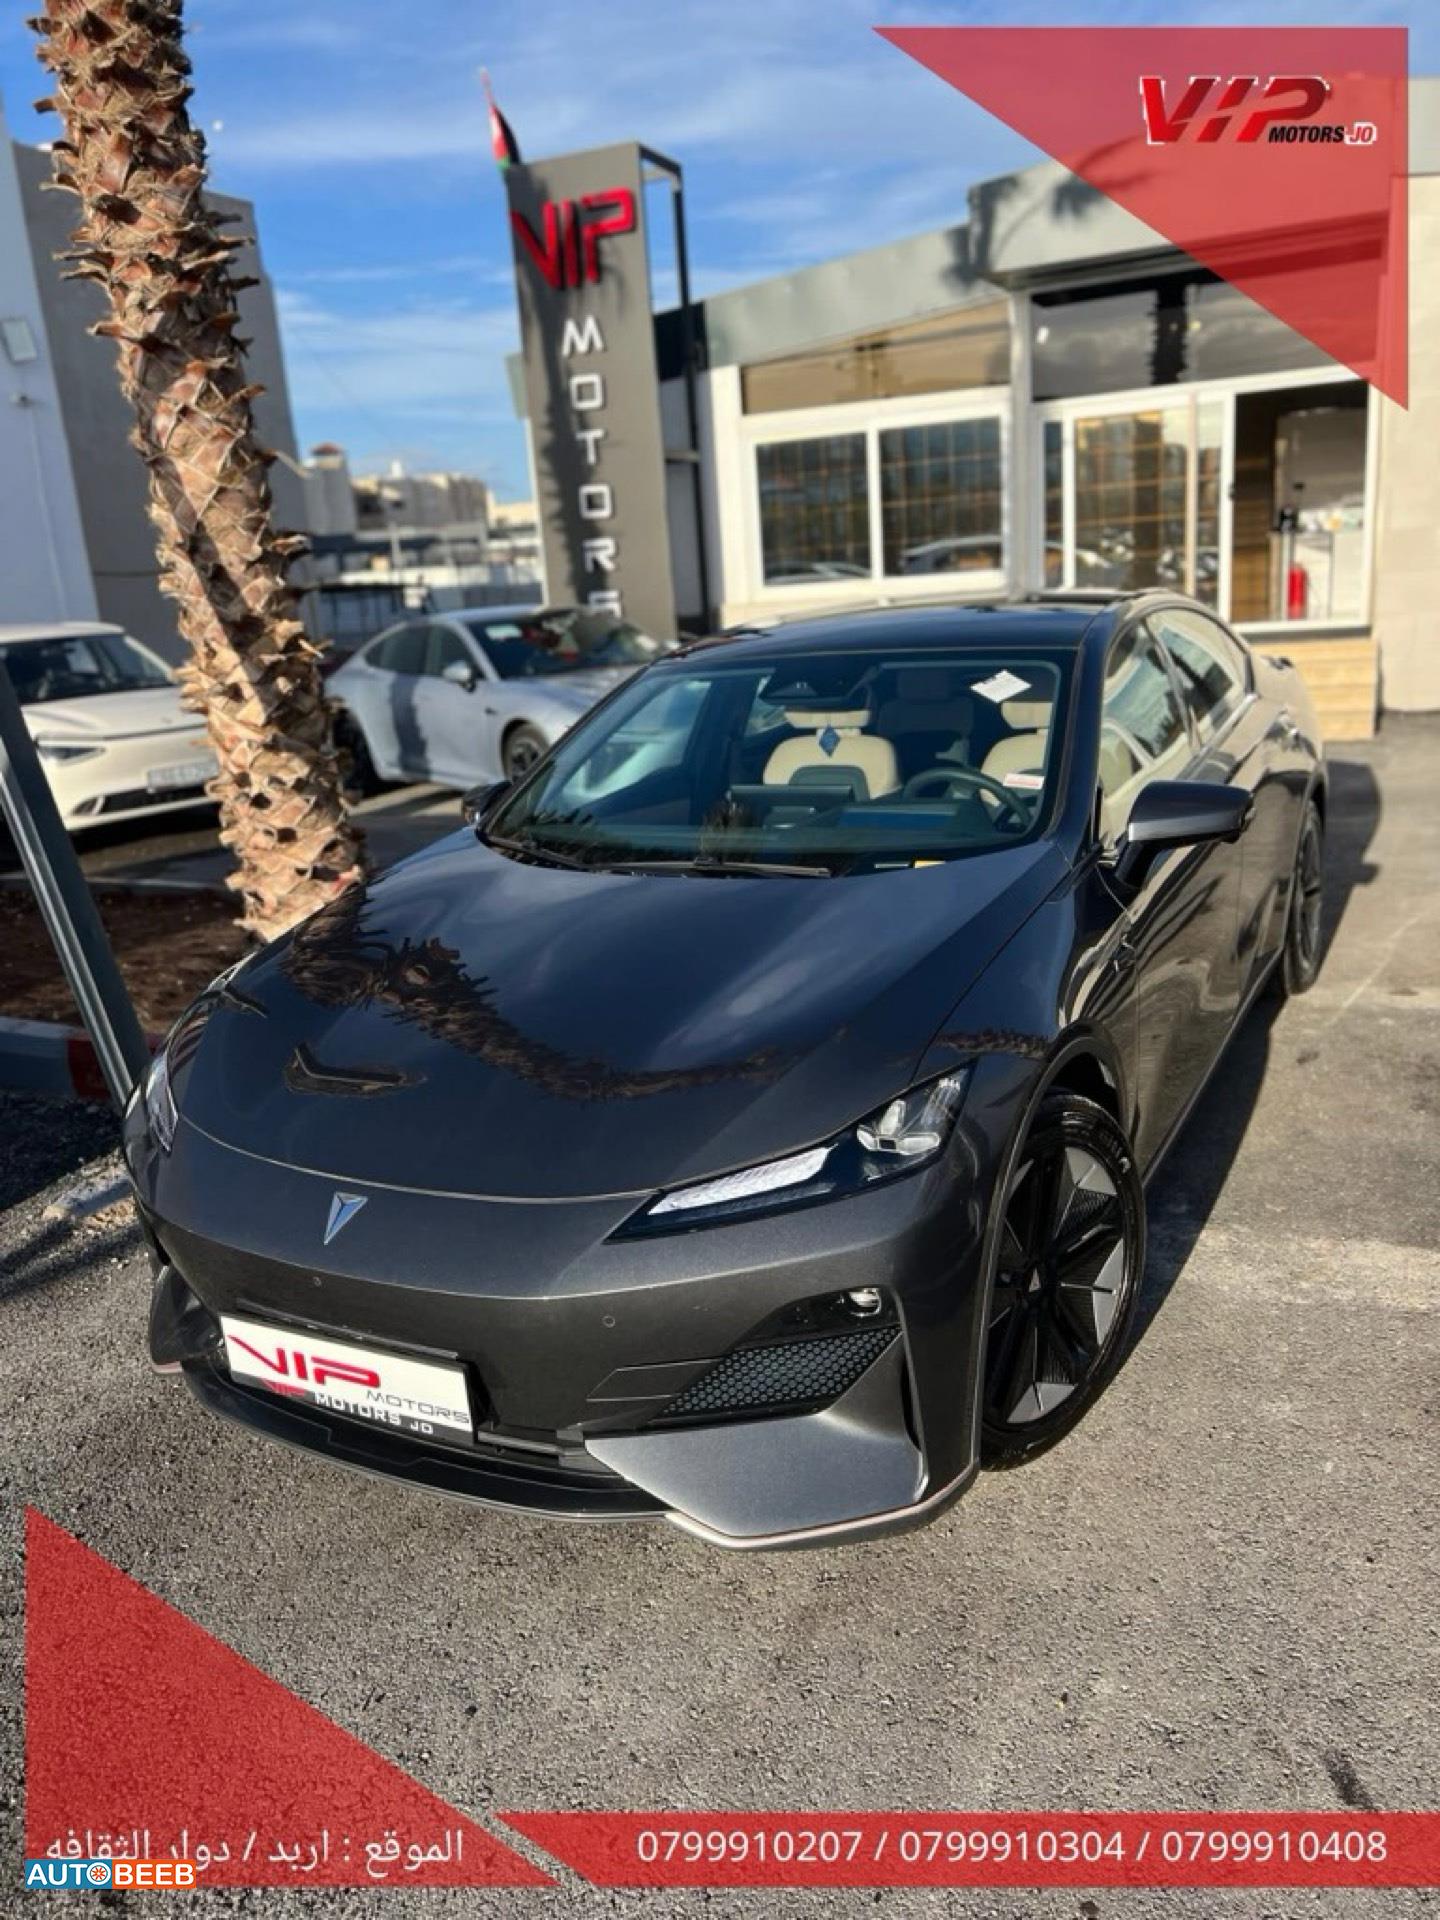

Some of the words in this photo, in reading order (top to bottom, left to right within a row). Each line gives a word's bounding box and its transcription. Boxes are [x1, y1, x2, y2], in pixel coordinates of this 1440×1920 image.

[510, 187, 636, 287] VIP
[227, 1334, 380, 1388] VIP
[315, 1392, 401, 1426] MOTORS
[367, 1391, 470, 1425] MOTORS
